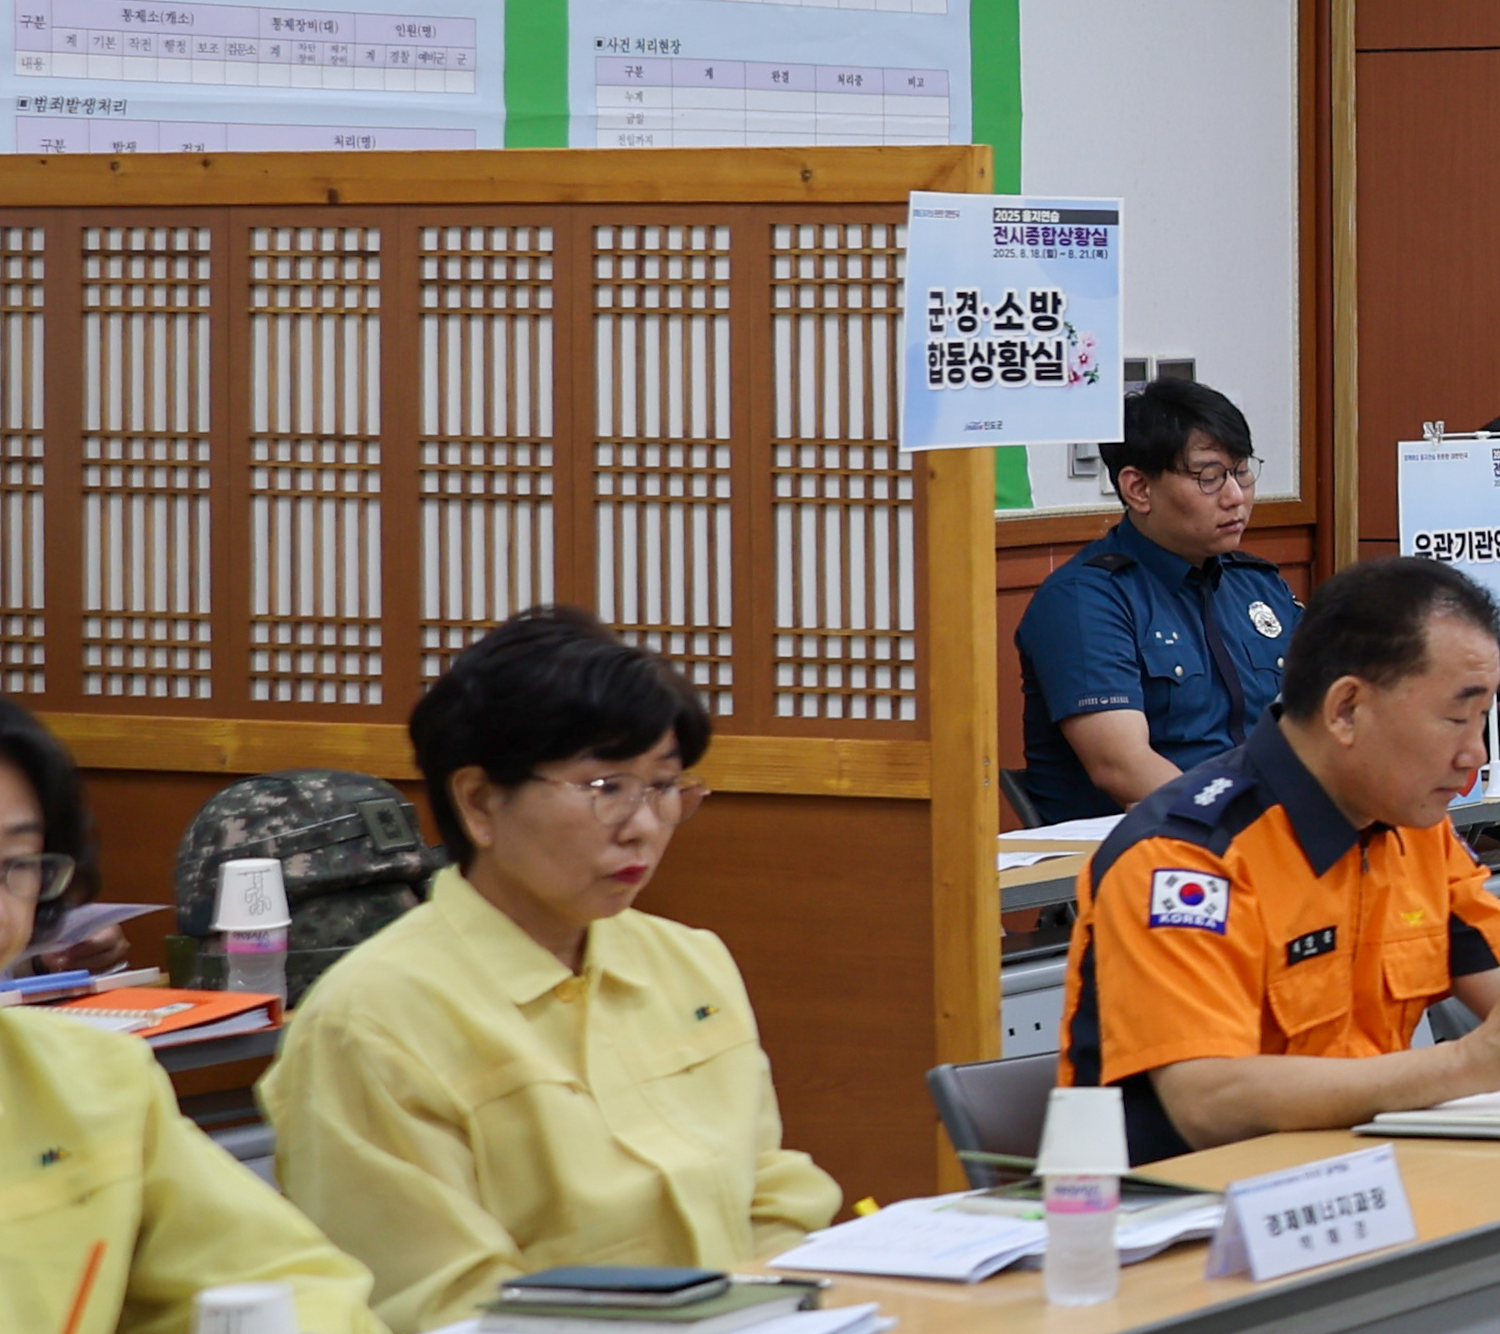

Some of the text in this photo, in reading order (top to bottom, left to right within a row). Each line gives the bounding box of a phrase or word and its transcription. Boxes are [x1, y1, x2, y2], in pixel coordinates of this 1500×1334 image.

[20, 15, 47, 29] 구분
[272, 17, 339, 34] 통제장비(대)
[395, 24, 437, 38] 인원(명)
[66, 34, 77, 47] 계
[93, 35, 117, 49] 기본
[129, 38, 152, 52] 작전
[607, 38, 630, 52] 사건
[199, 42, 220, 54] 보조
[22, 57, 45, 71] 내용
[391, 51, 410, 64] 경찰
[457, 53, 467, 66] 군
[624, 65, 644, 79] 구분
[624, 90, 644, 104] 누계
[34, 96, 127, 116] 범죄발생처리
[40, 139, 66, 152] 구분
[334, 135, 376, 150] 처리(명)
[994, 210, 1060, 223] 2025 을지연습
[993, 226, 1108, 247] 전시종합상황실
[993, 249, 1018, 258] 2025.
[928, 291, 1063, 332] 군·경·소방
[928, 340, 1064, 385] 합동상황실
[1158, 913, 1217, 929] KOREA
